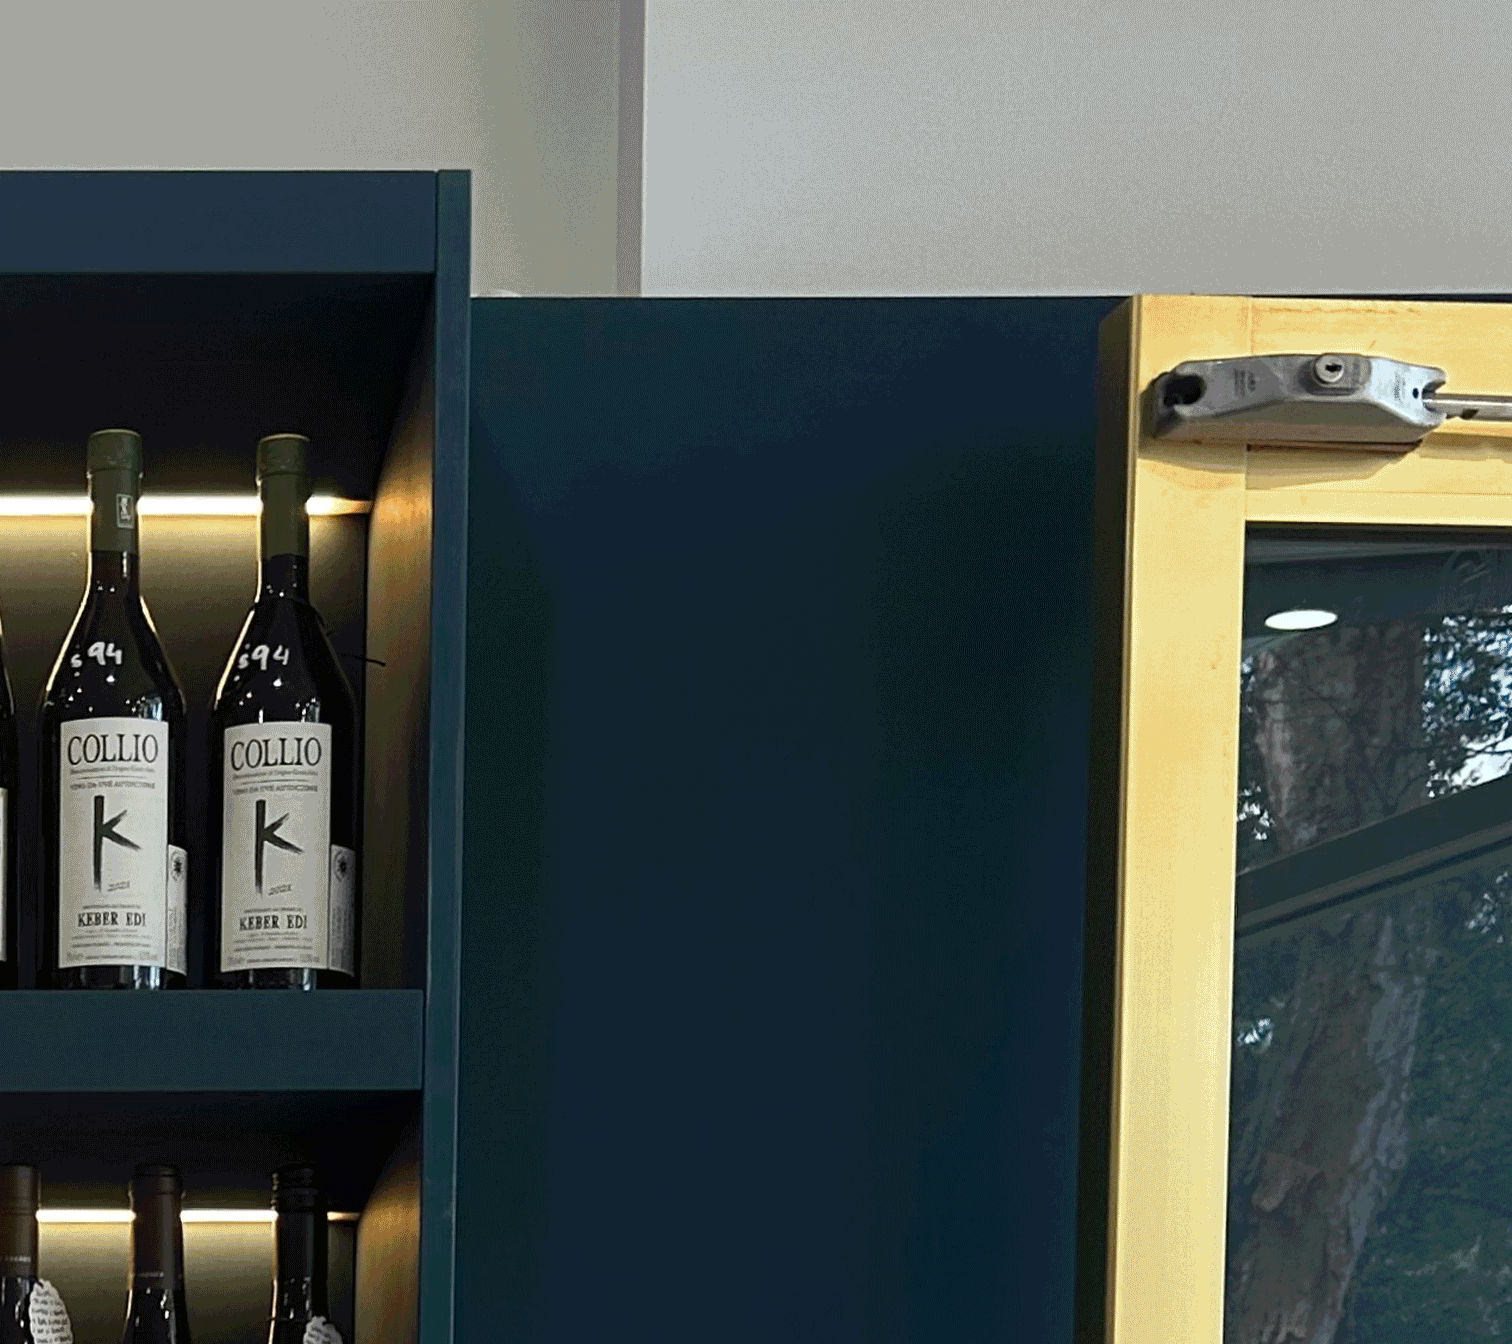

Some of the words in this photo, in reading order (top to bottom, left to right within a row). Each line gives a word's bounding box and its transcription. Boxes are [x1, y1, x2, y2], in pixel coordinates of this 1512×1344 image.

[71, 642, 123, 676] $94
[237, 644, 289, 681] $94
[67, 734, 159, 766] COLLIO
[231, 737, 323, 771] COLLIO
[93, 795, 142, 892] K
[256, 799, 304, 898] K
[78, 911, 118, 927] KEBER
[126, 911, 146, 927] EDI
[239, 915, 279, 931] KEBER
[288, 914, 308, 930] EDI
